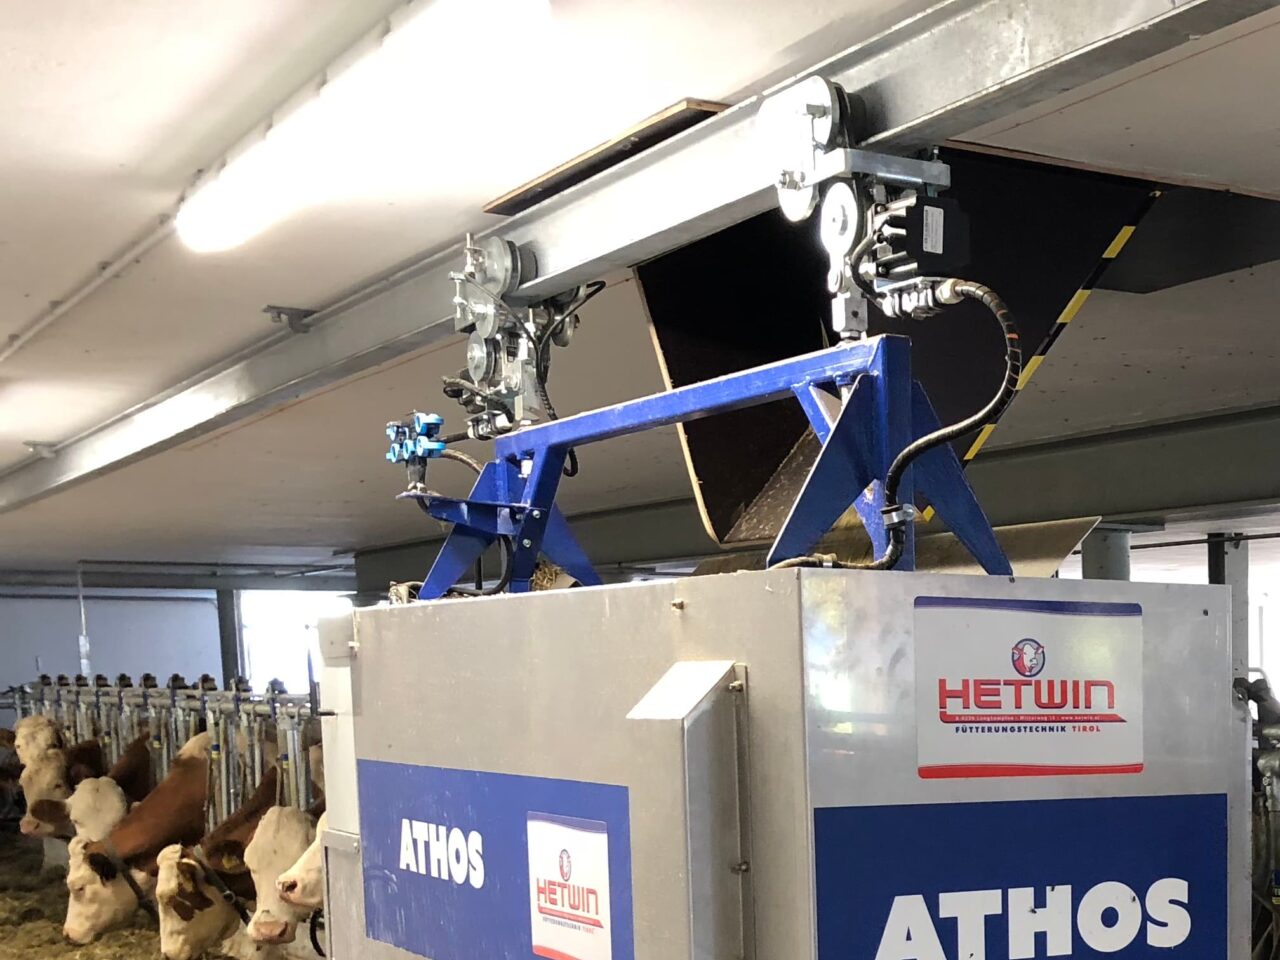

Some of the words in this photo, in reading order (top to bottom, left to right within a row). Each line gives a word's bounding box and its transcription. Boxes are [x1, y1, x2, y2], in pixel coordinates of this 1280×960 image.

[938, 679, 1115, 709] HETWIN
[955, 724, 1067, 733] FÜTTERUNGSTECHNIK
[400, 818, 485, 888] ATHOS
[537, 877, 599, 915] HETWIN
